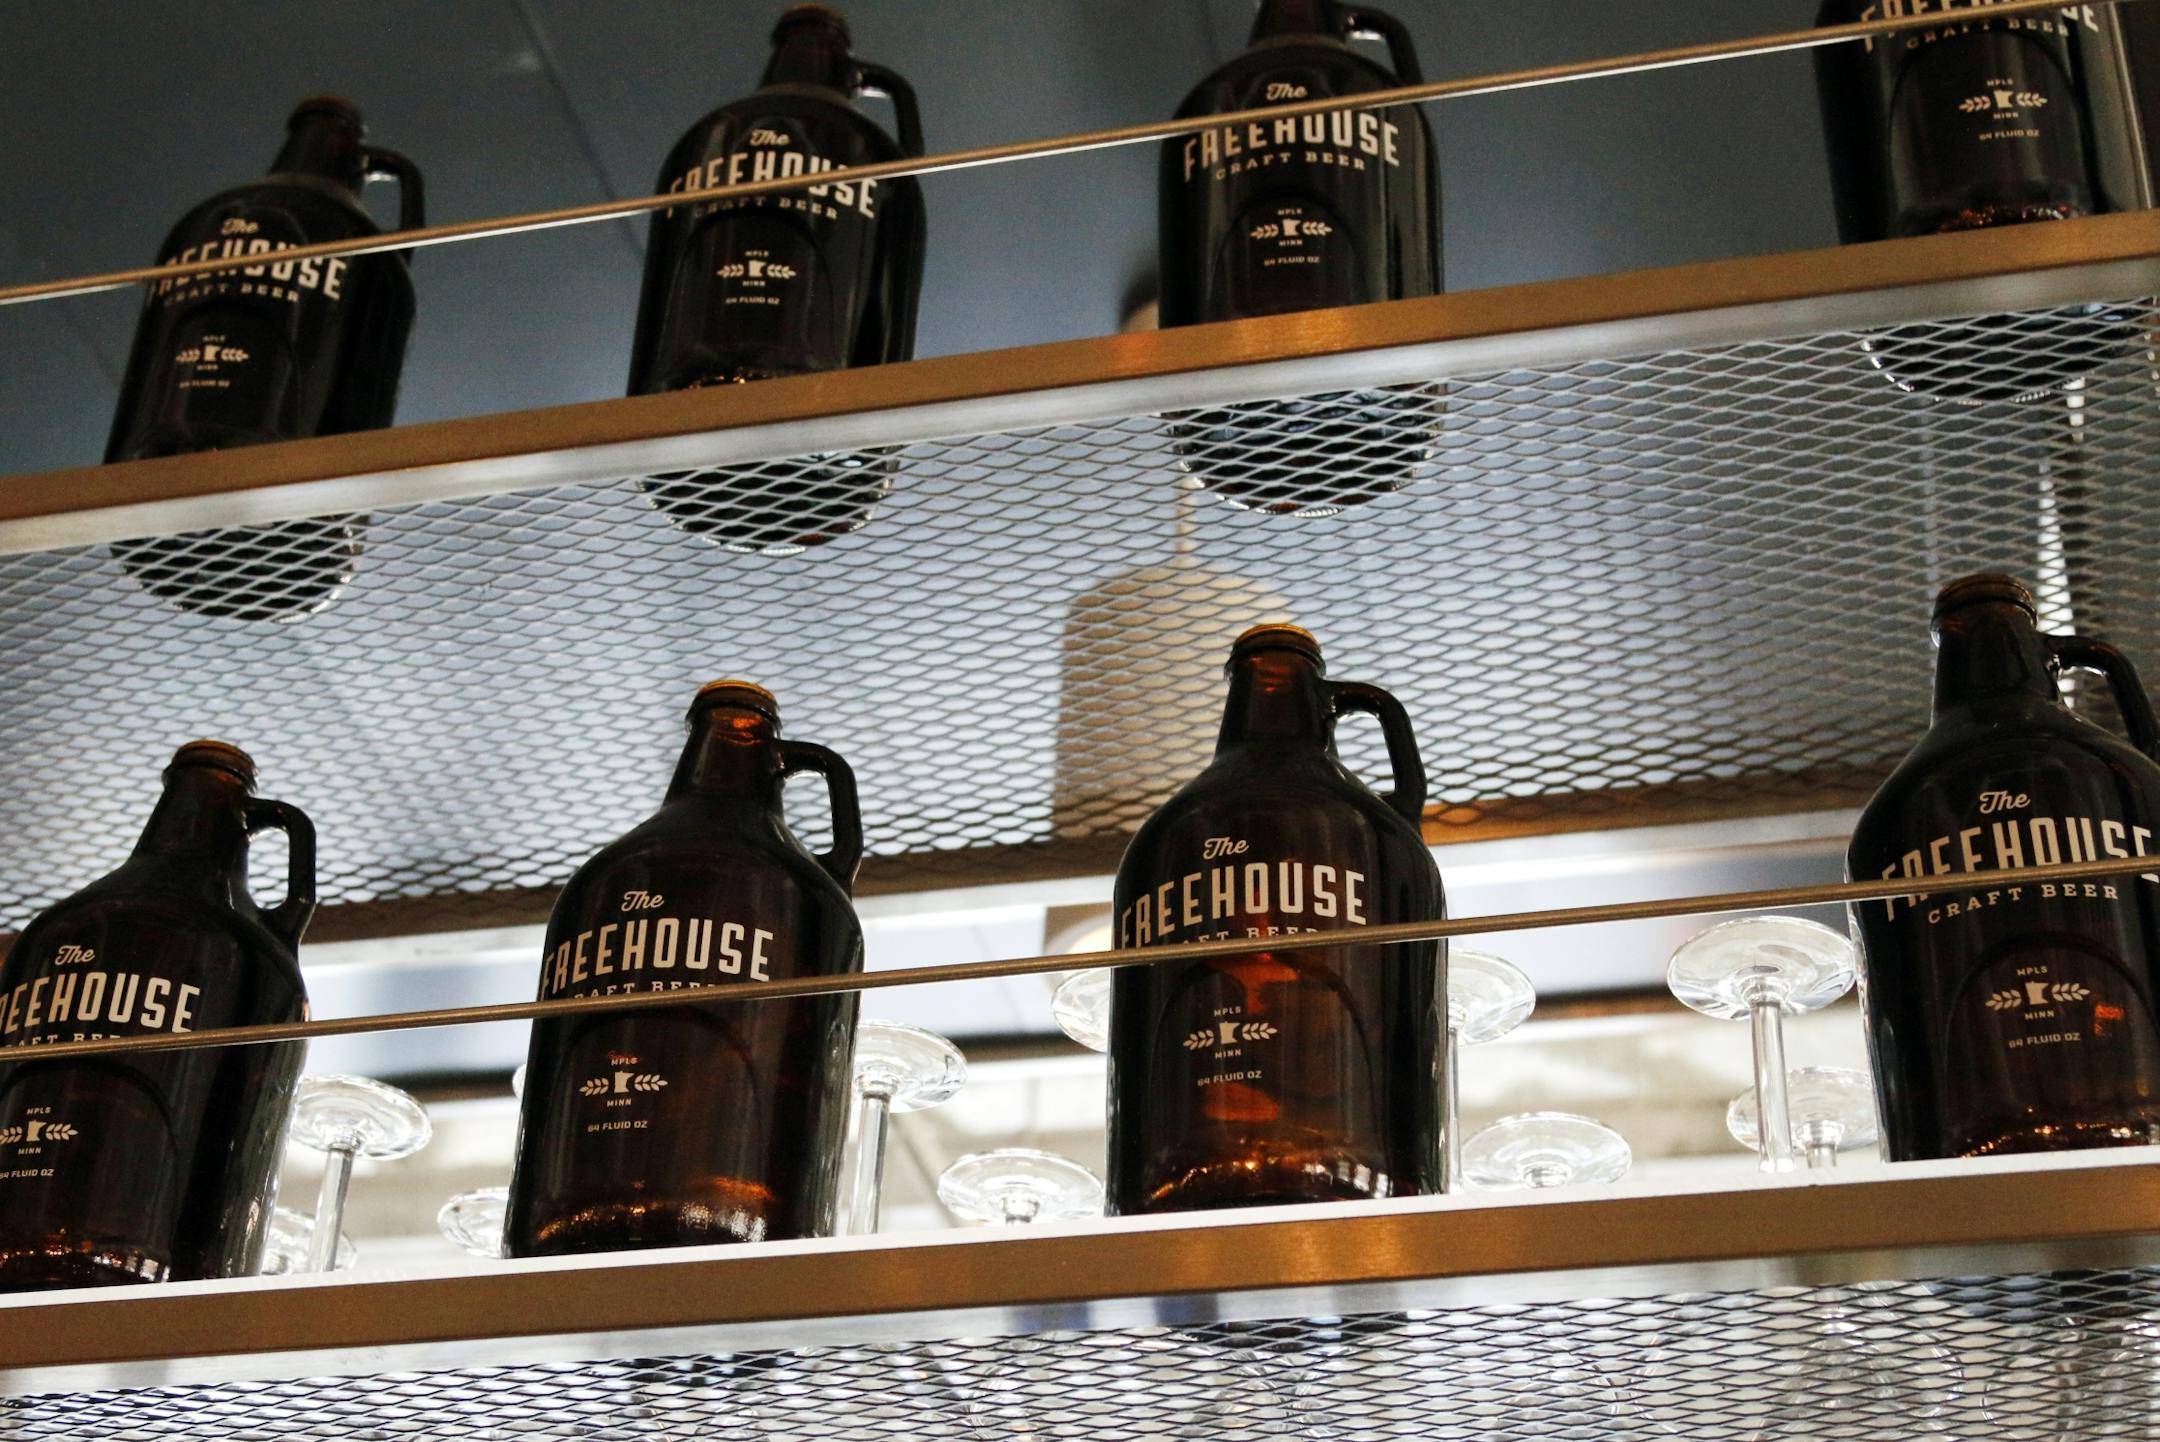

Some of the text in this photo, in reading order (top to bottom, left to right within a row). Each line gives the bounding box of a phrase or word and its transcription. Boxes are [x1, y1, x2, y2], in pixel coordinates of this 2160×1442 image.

[1266, 82, 1308, 100] The
[750, 129, 790, 146] The
[1215, 151, 1365, 180] CRAFT BEER
[1979, 790, 2031, 814] The
[1203, 836, 1249, 860] The
[621, 890, 665, 912] The
[1121, 861, 1367, 949] FREEHOUSE
[1928, 883, 2119, 924] CRAFT BEER
[54, 944, 95, 966] The
[541, 917, 774, 1000] FREEHOUSE
[2016, 965, 2048, 976] MPLS
[1213, 1006, 1241, 1017] MPLS
[2027, 1033, 2061, 1046] FLUID
[2064, 1032, 2081, 1042] OZ
[1213, 1072, 1244, 1083] FLUID
[1247, 1070, 1262, 1080] OZ
[602, 1120, 632, 1131] FLUID
[634, 1119, 648, 1129] OZ
[11, 1169, 39, 1178] FLUID
[40, 1168, 54, 1177] OZ
